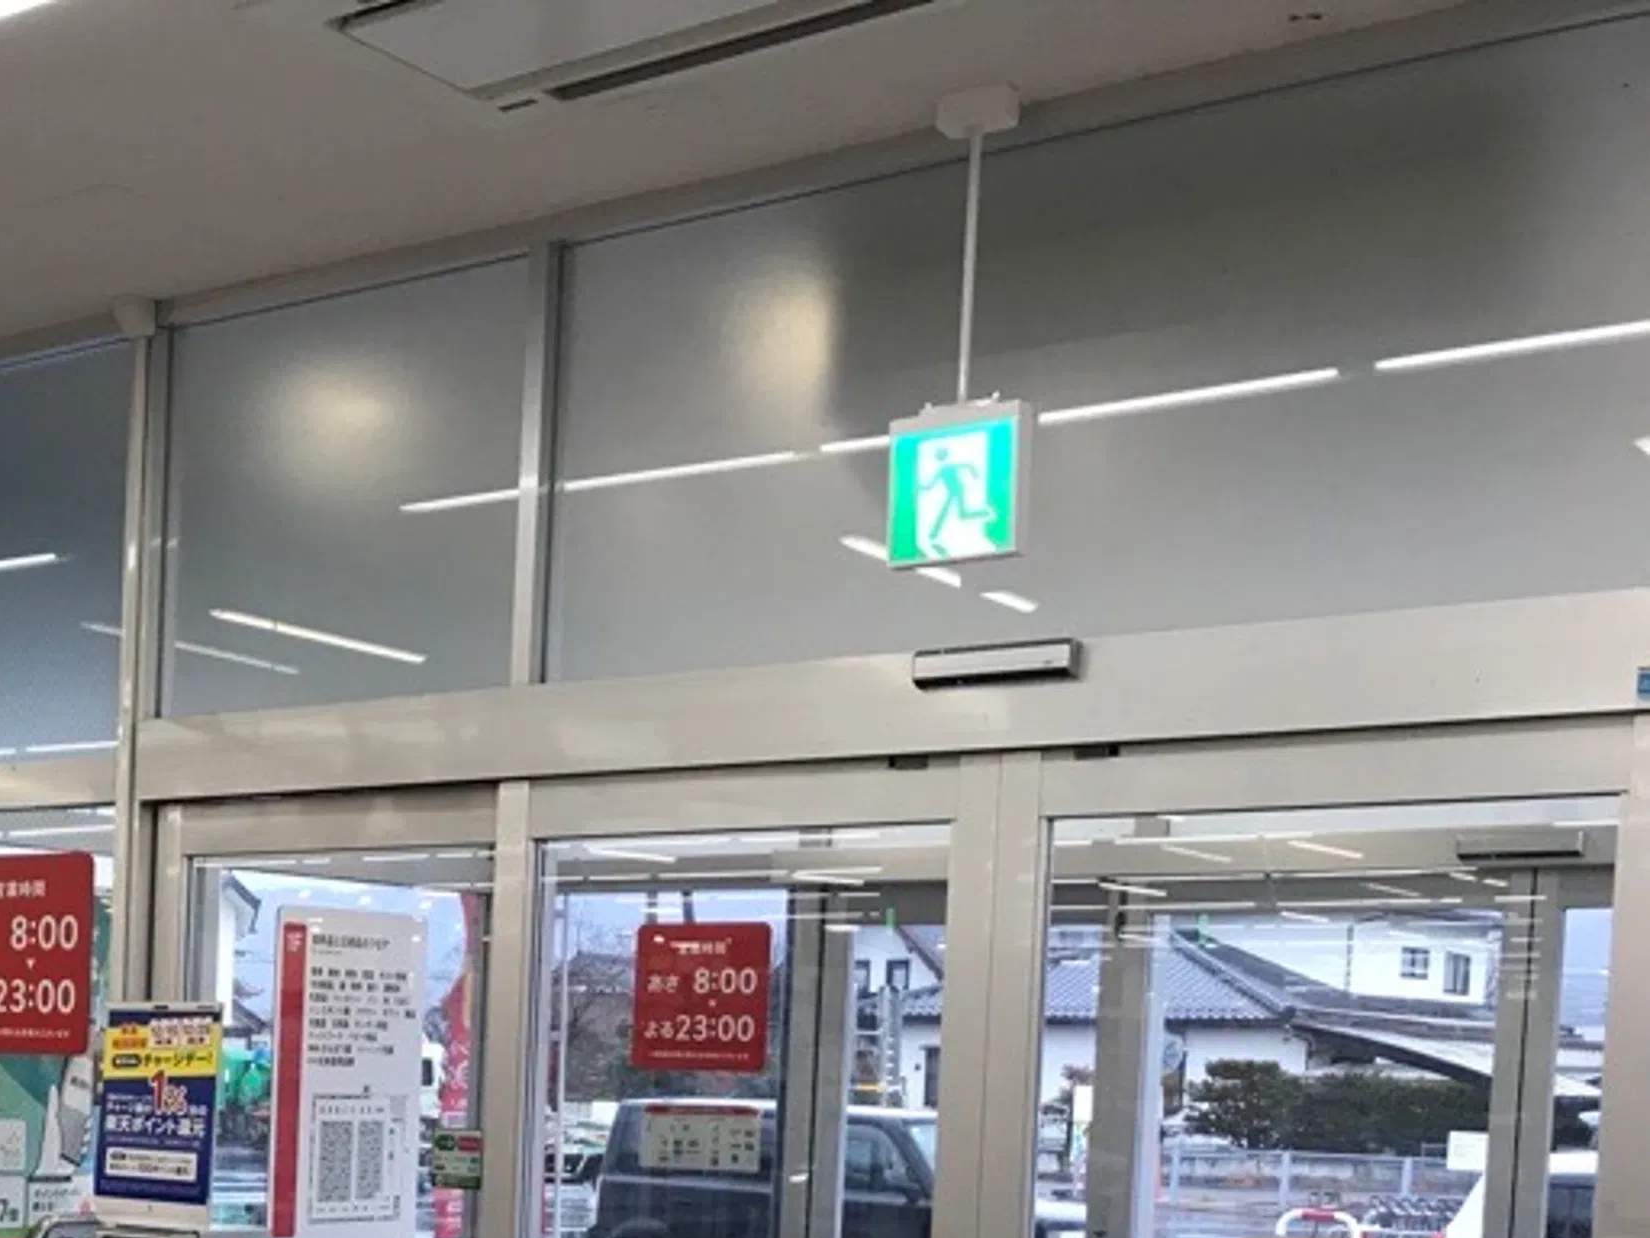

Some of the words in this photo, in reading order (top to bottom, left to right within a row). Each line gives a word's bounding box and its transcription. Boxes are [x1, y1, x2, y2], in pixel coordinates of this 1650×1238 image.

[10, 914, 78, 950] 8:00
[693, 966, 757, 995] 8:00
[675, 1013, 754, 1042] 23:00
